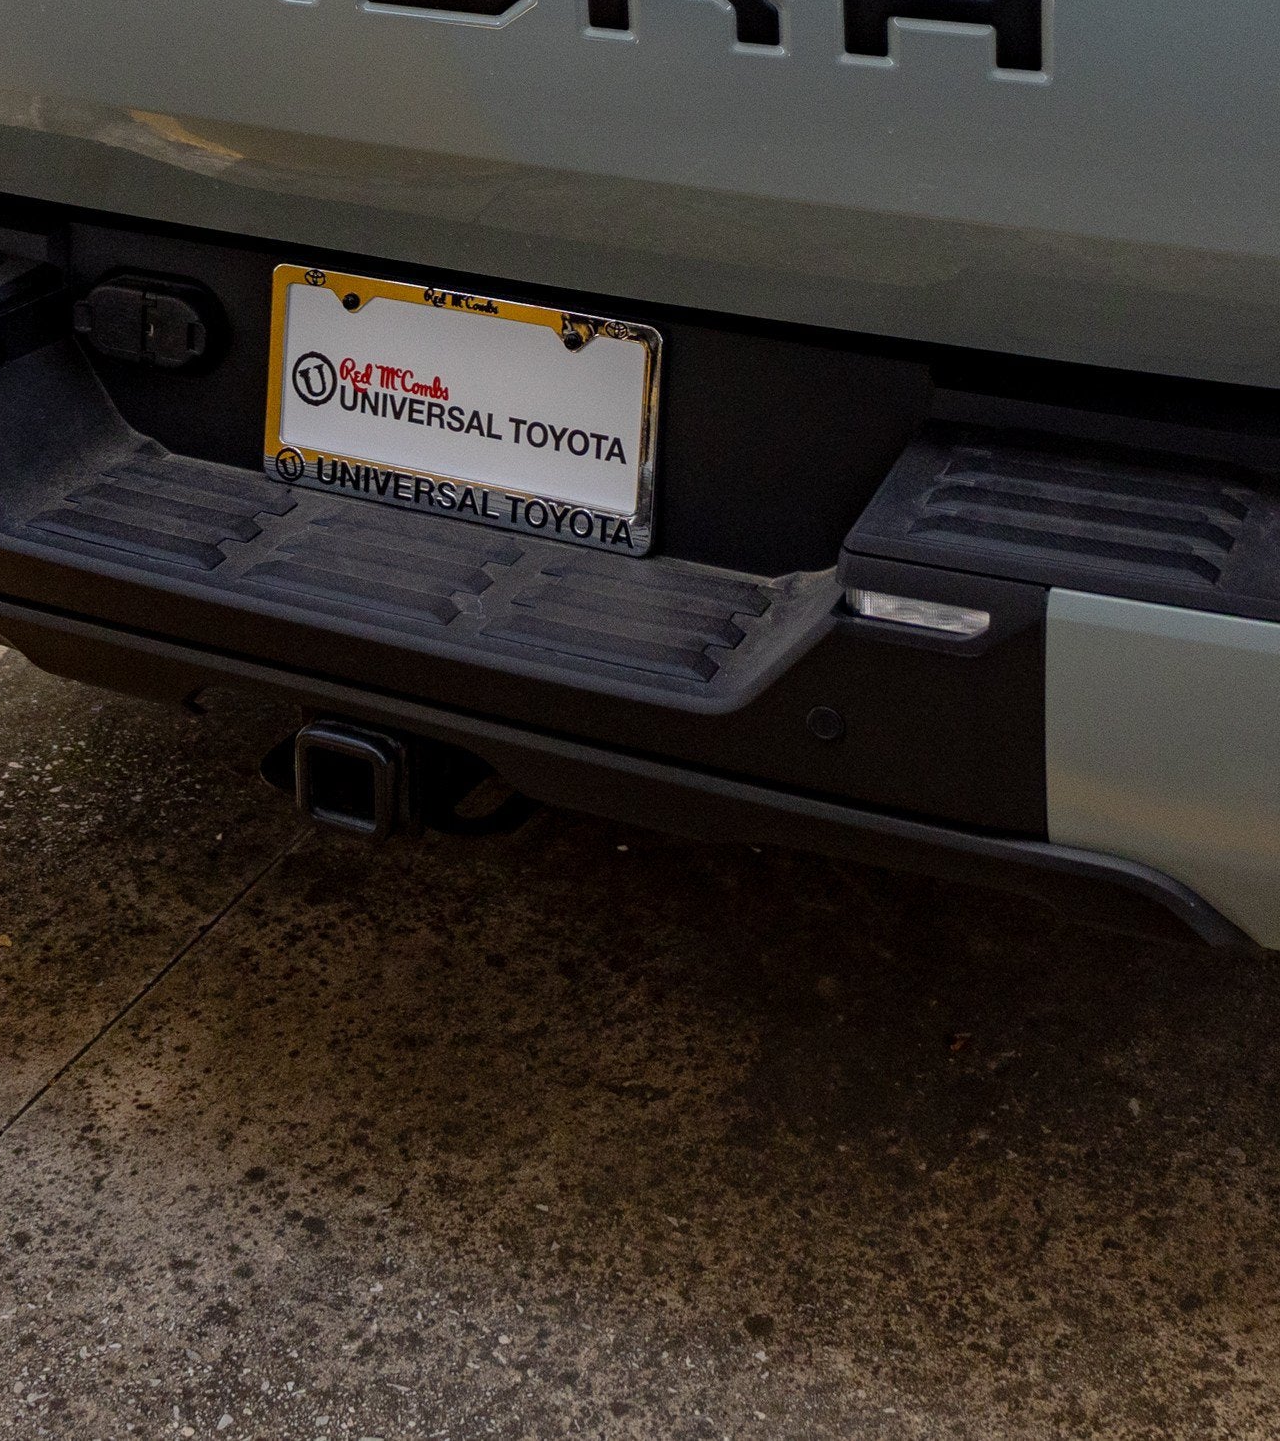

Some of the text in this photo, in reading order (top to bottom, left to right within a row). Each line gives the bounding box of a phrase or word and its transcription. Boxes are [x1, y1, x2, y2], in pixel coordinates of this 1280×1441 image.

[423, 286, 499, 315] Red McCombs
[339, 357, 450, 401] Red McCombs
[339, 384, 628, 466] UNIVERSAL TOYOTA
[315, 454, 634, 549] UNIVERSAL TOYOTA
